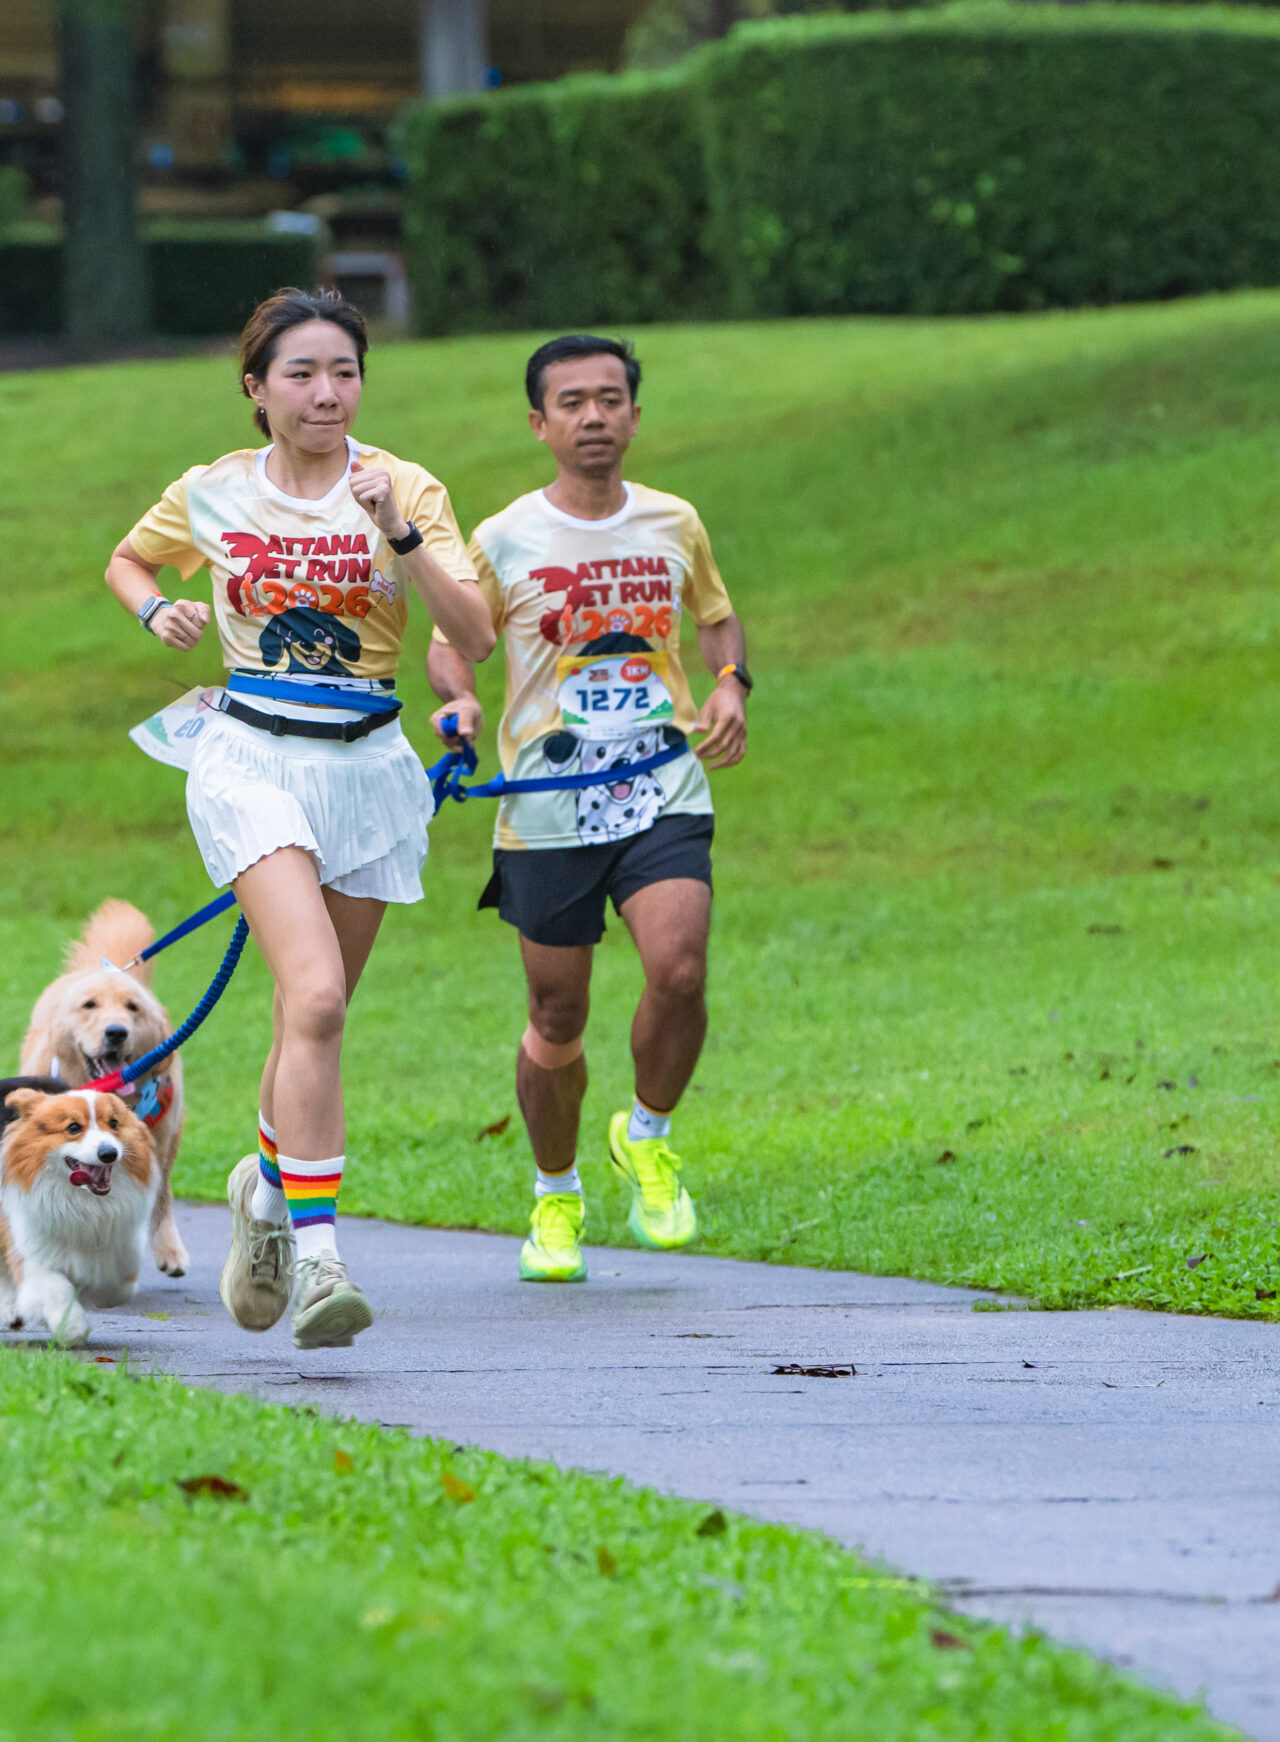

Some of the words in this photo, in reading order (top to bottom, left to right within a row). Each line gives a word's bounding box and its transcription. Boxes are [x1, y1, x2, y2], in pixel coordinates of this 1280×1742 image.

[307, 558, 370, 583] RUN
[261, 581, 371, 618] 2026
[620, 580, 672, 604] RUN
[581, 604, 672, 642] 2026
[576, 687, 650, 712] 1272
